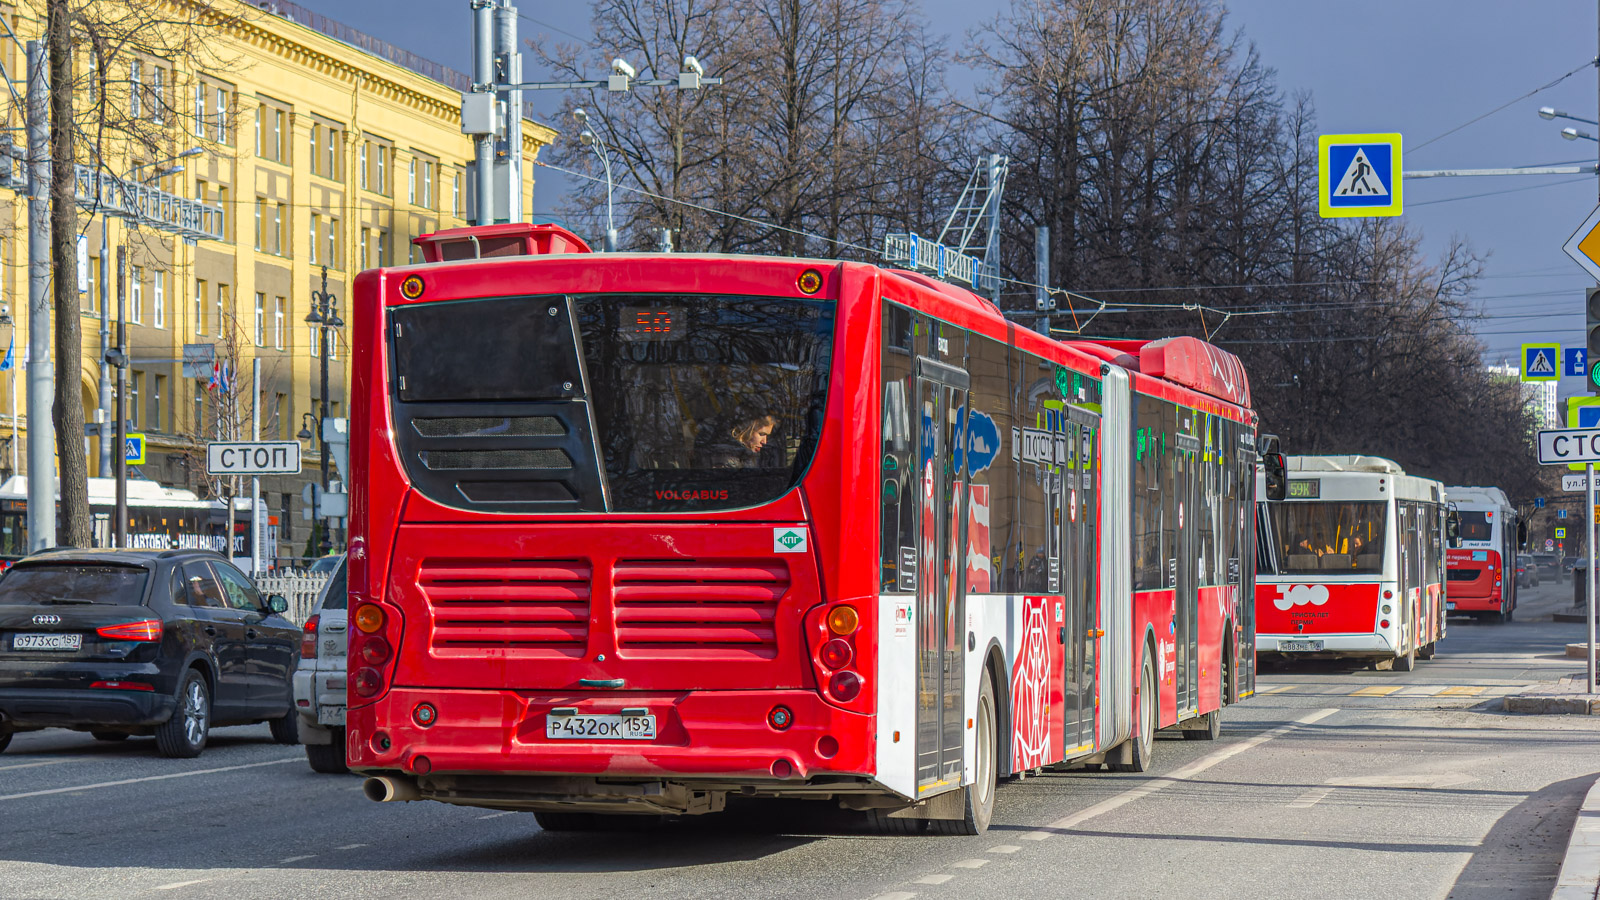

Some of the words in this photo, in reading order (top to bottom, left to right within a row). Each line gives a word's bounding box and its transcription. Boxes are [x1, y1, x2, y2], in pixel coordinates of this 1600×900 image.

[221, 448, 287, 468] СТОП
[655, 490, 728, 500] VOLGABUS
[134, 533, 171, 549] АВТОБУС
[179, 533, 198, 549] НАШ
[781, 536, 799, 544] КПГ
[1273, 584, 1329, 611] 300
[61, 635, 77, 644] 159
[552, 718, 620, 735] Р432ОК
[624, 718, 650, 731] 159
